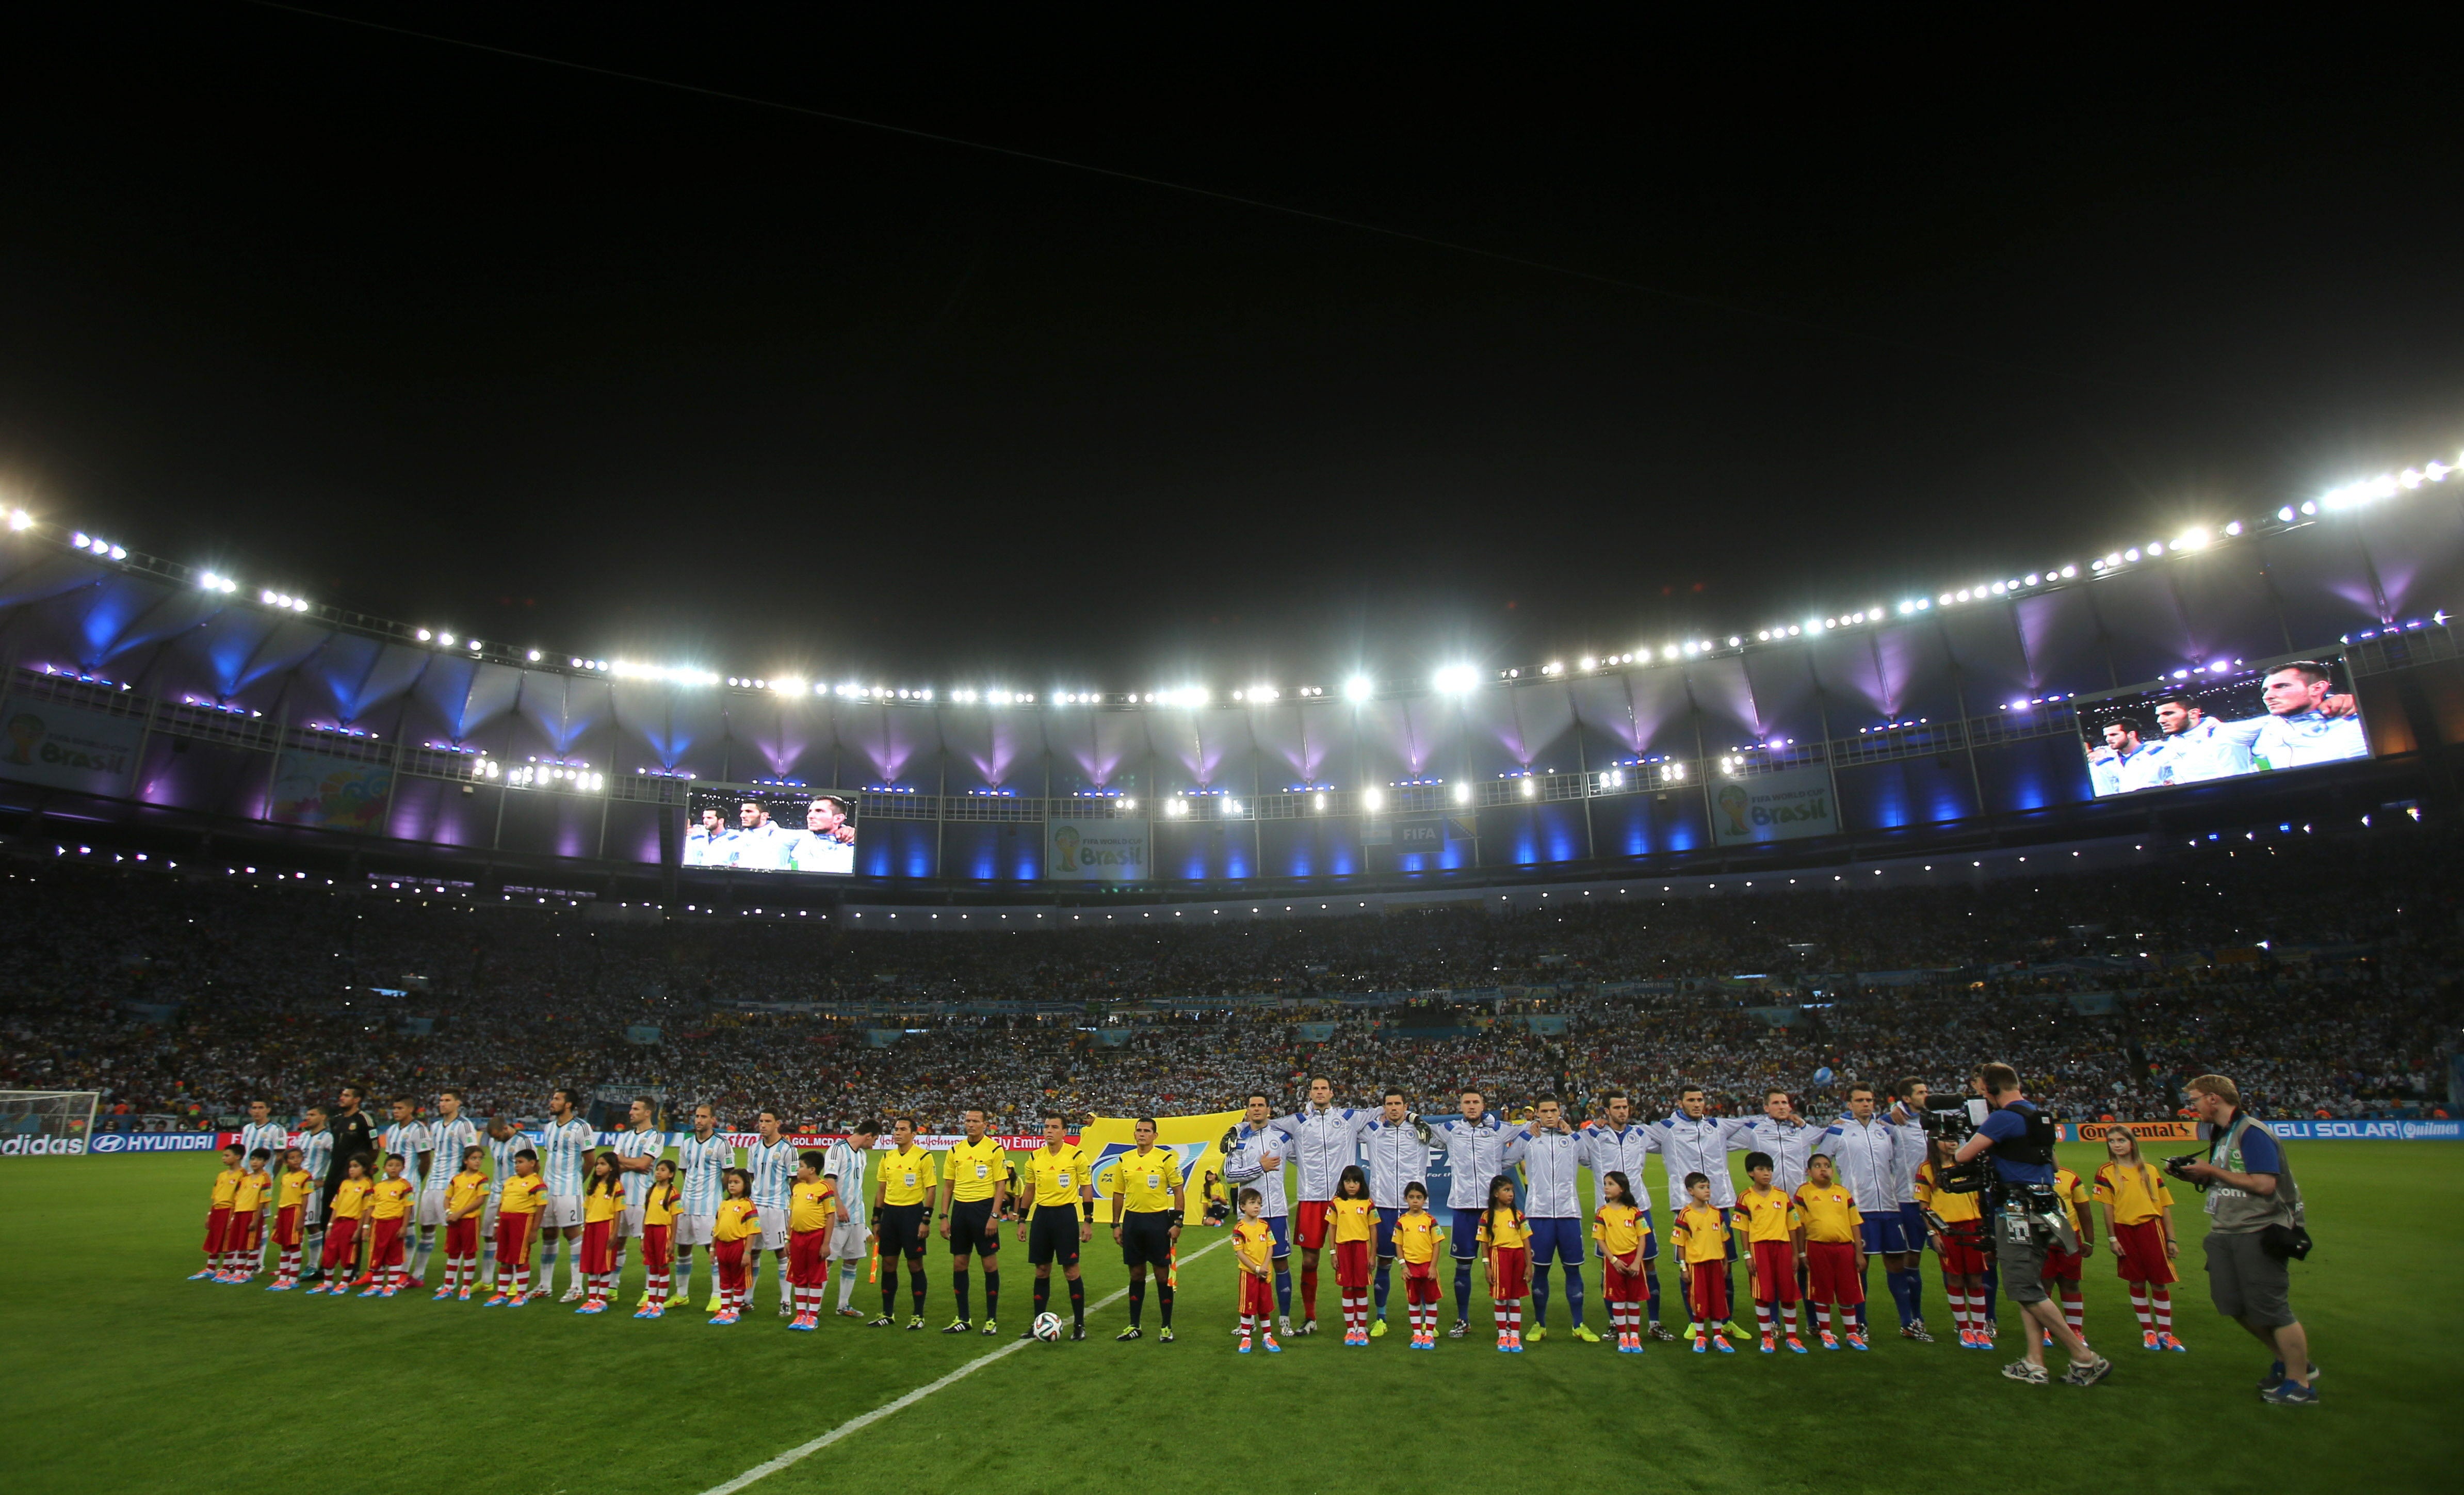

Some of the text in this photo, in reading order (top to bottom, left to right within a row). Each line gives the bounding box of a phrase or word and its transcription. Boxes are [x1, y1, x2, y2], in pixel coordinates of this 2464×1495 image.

[40, 742, 126, 775] Brasil
[1751, 788, 1825, 803] FIFA WORLD CUP
[1751, 798, 1827, 826] Brasil
[1403, 827, 1436, 840] FIFA
[1080, 846, 1142, 866] Brasil
[2079, 1123, 2175, 1140] Conental
[2268, 1123, 2398, 1137] GLI SOLAR
[2403, 1121, 2459, 1138] Quilmes
[0, 1134, 84, 1155] didas
[127, 1135, 215, 1151] HYUNDAI
[1013, 1136, 1048, 1149] Emira
[853, 1167, 860, 1180] 10
[570, 1209, 576, 1222] 2
[777, 1230, 785, 1244] 11
